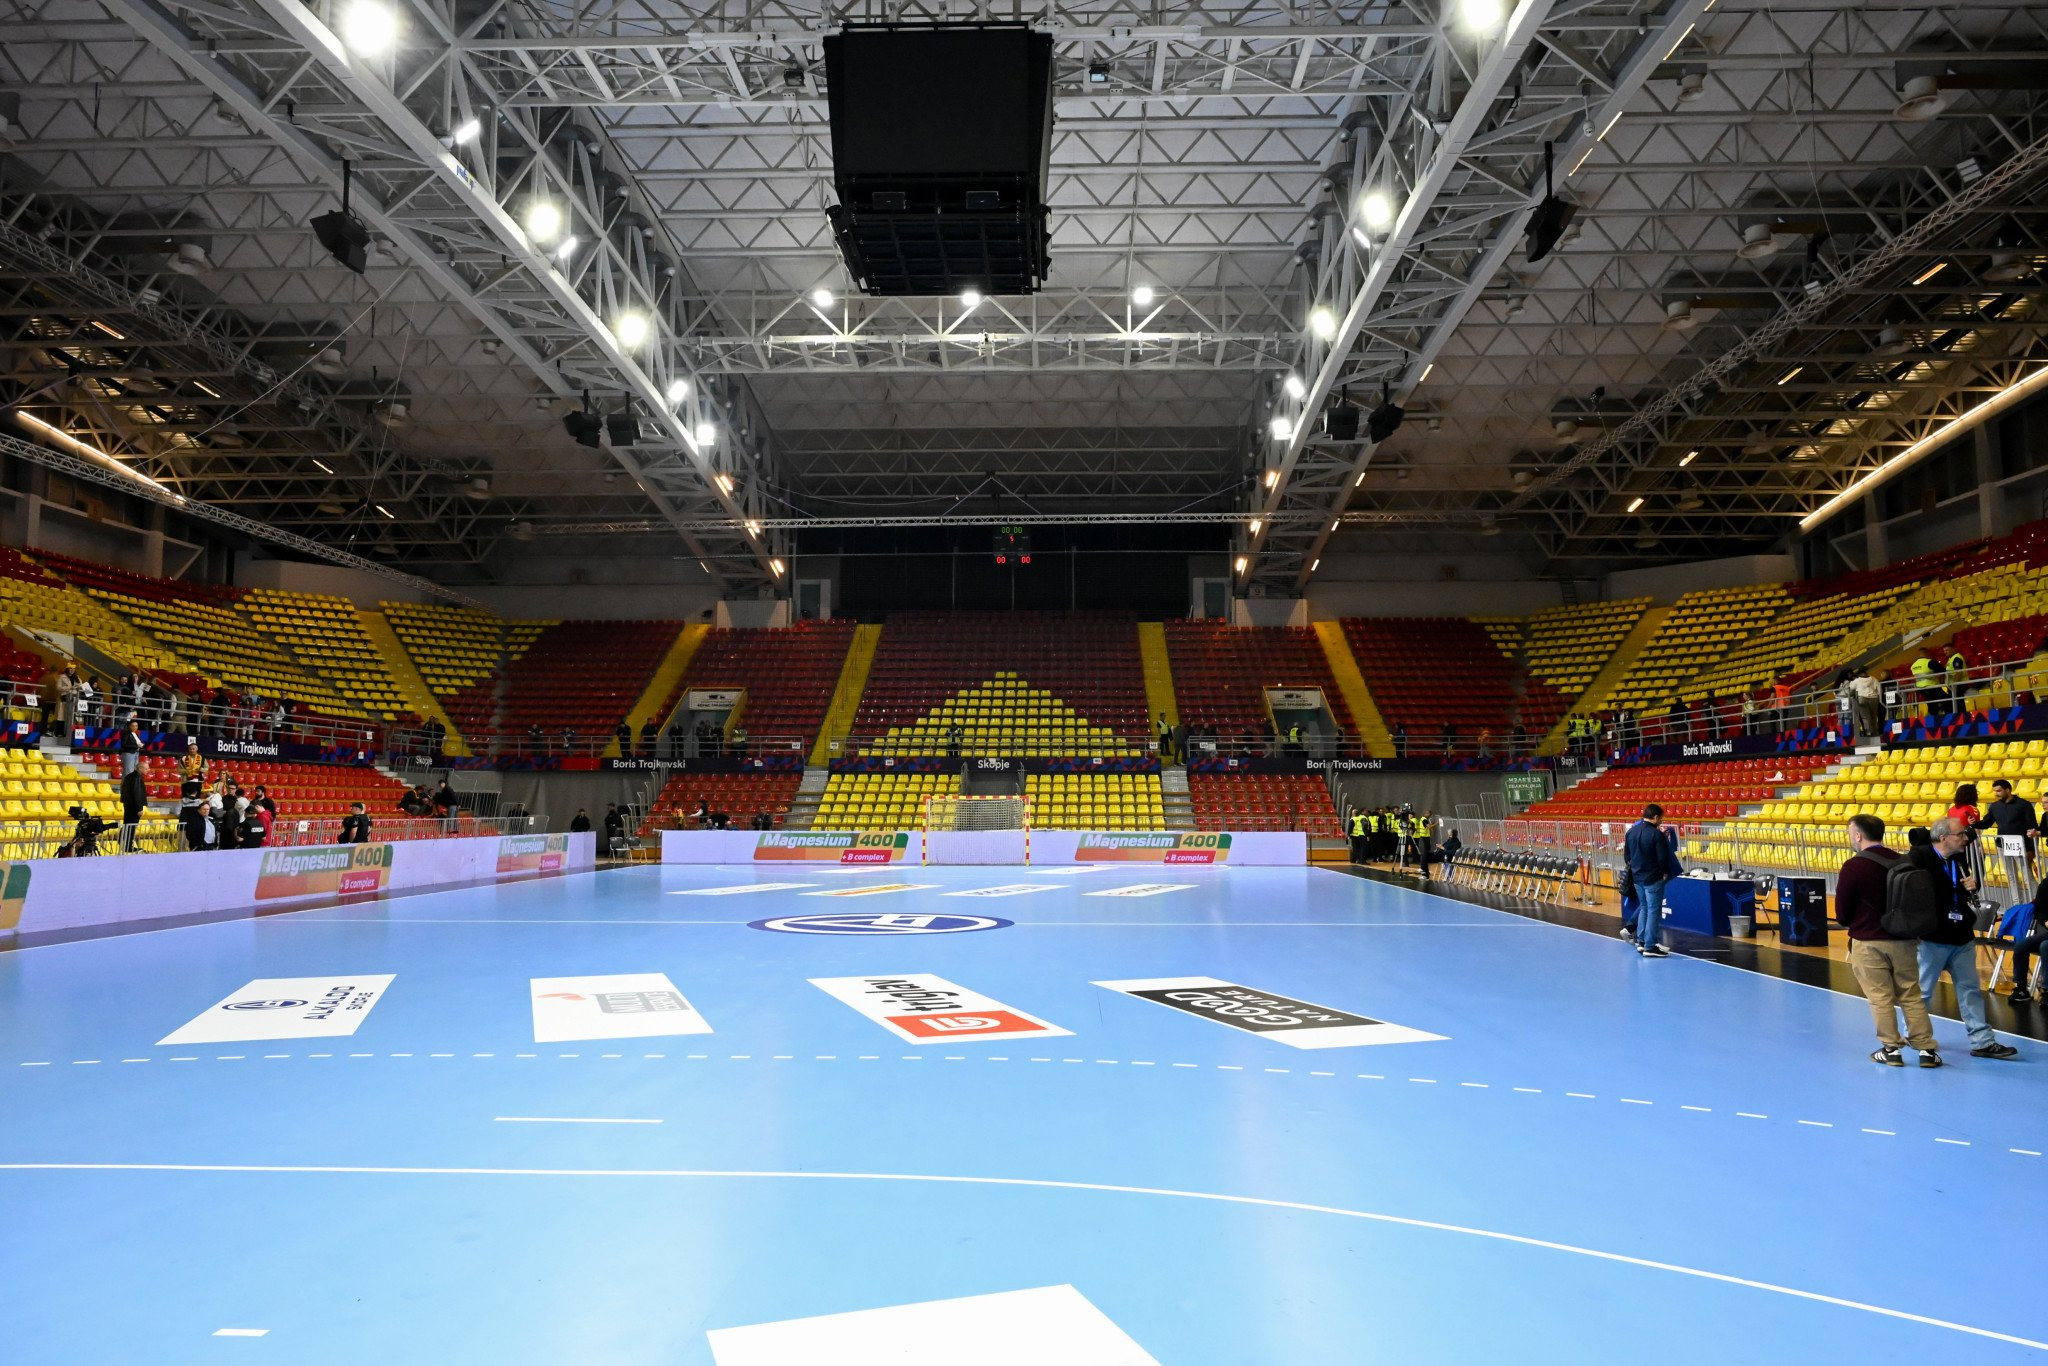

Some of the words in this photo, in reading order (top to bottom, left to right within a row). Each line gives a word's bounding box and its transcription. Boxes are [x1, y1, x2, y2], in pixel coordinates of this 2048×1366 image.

[1001, 526, 1011, 534] 00
[1013, 526, 1023, 534] 00
[996, 556, 1006, 564] 00
[1021, 556, 1031, 564] 00
[217, 740, 239, 753] Boris
[240, 741, 278, 757] Trajkovski
[1683, 744, 1699, 756] Boris
[1699, 740, 1733, 757] Trajkovski
[613, 759, 636, 768] Boris
[638, 759, 686, 770] Trajkovski
[977, 759, 1010, 771] Skopje
[1332, 759, 1382, 771] Trajkovski
[502, 837, 546, 857] Magnesium
[547, 835, 562, 851] 400
[763, 833, 851, 849] Magnesium
[859, 834, 893, 847] 400
[1085, 834, 1174, 850] Magnesium
[1183, 835, 1216, 847] 400
[266, 849, 349, 876] Magnesium
[355, 847, 382, 866] 400
[853, 853, 884, 862] complex
[1177, 854, 1208, 862] complex
[344, 879, 350, 889] B
[350, 877, 375, 890] complex
[303, 985, 356, 1020] ALKALOID
[864, 979, 963, 1012] triglav
[1164, 991, 1303, 1026] GOOD
[1216, 990, 1344, 1022] NATURE
